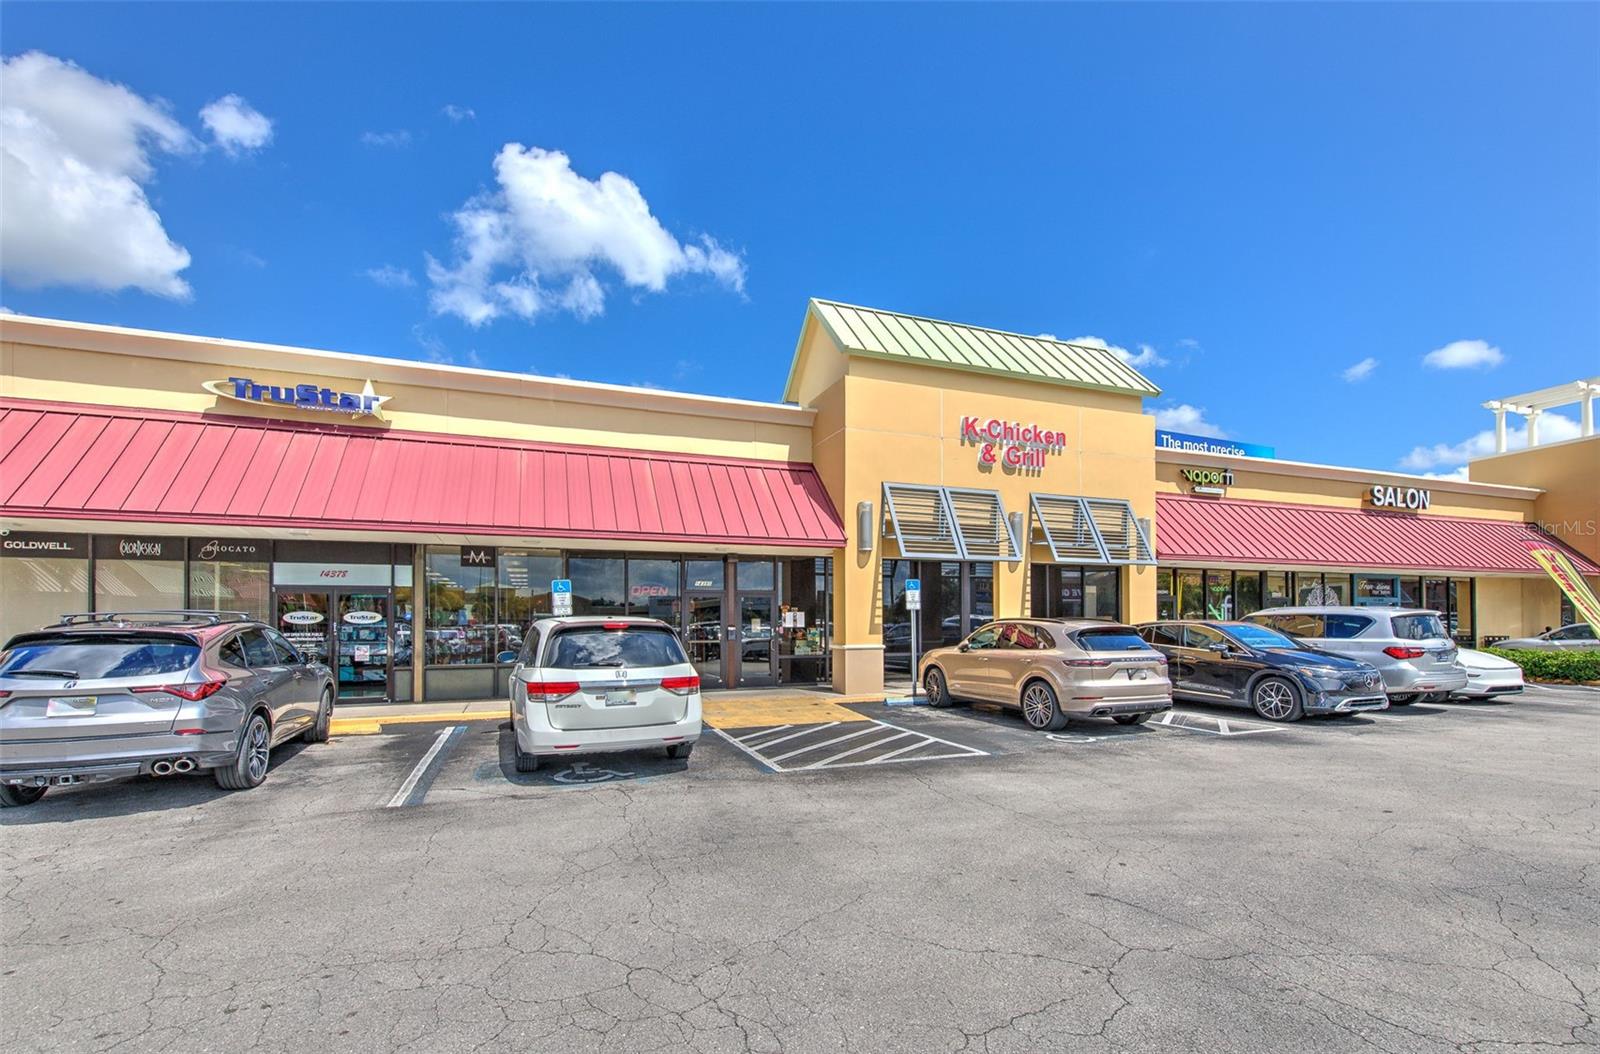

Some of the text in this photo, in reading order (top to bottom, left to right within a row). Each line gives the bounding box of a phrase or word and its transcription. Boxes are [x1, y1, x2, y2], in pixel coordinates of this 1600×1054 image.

[228, 377, 379, 410] TruStar
[963, 416, 1066, 446] K-Chicken
[982, 443, 1045, 467] & Grill
[1161, 434, 1245, 456] The most precise
[1372, 485, 1430, 510] SALON
[3, 540, 72, 551] GOLDWELL
[469, 550, 487, 564] M
[631, 585, 669, 596] OPEN
